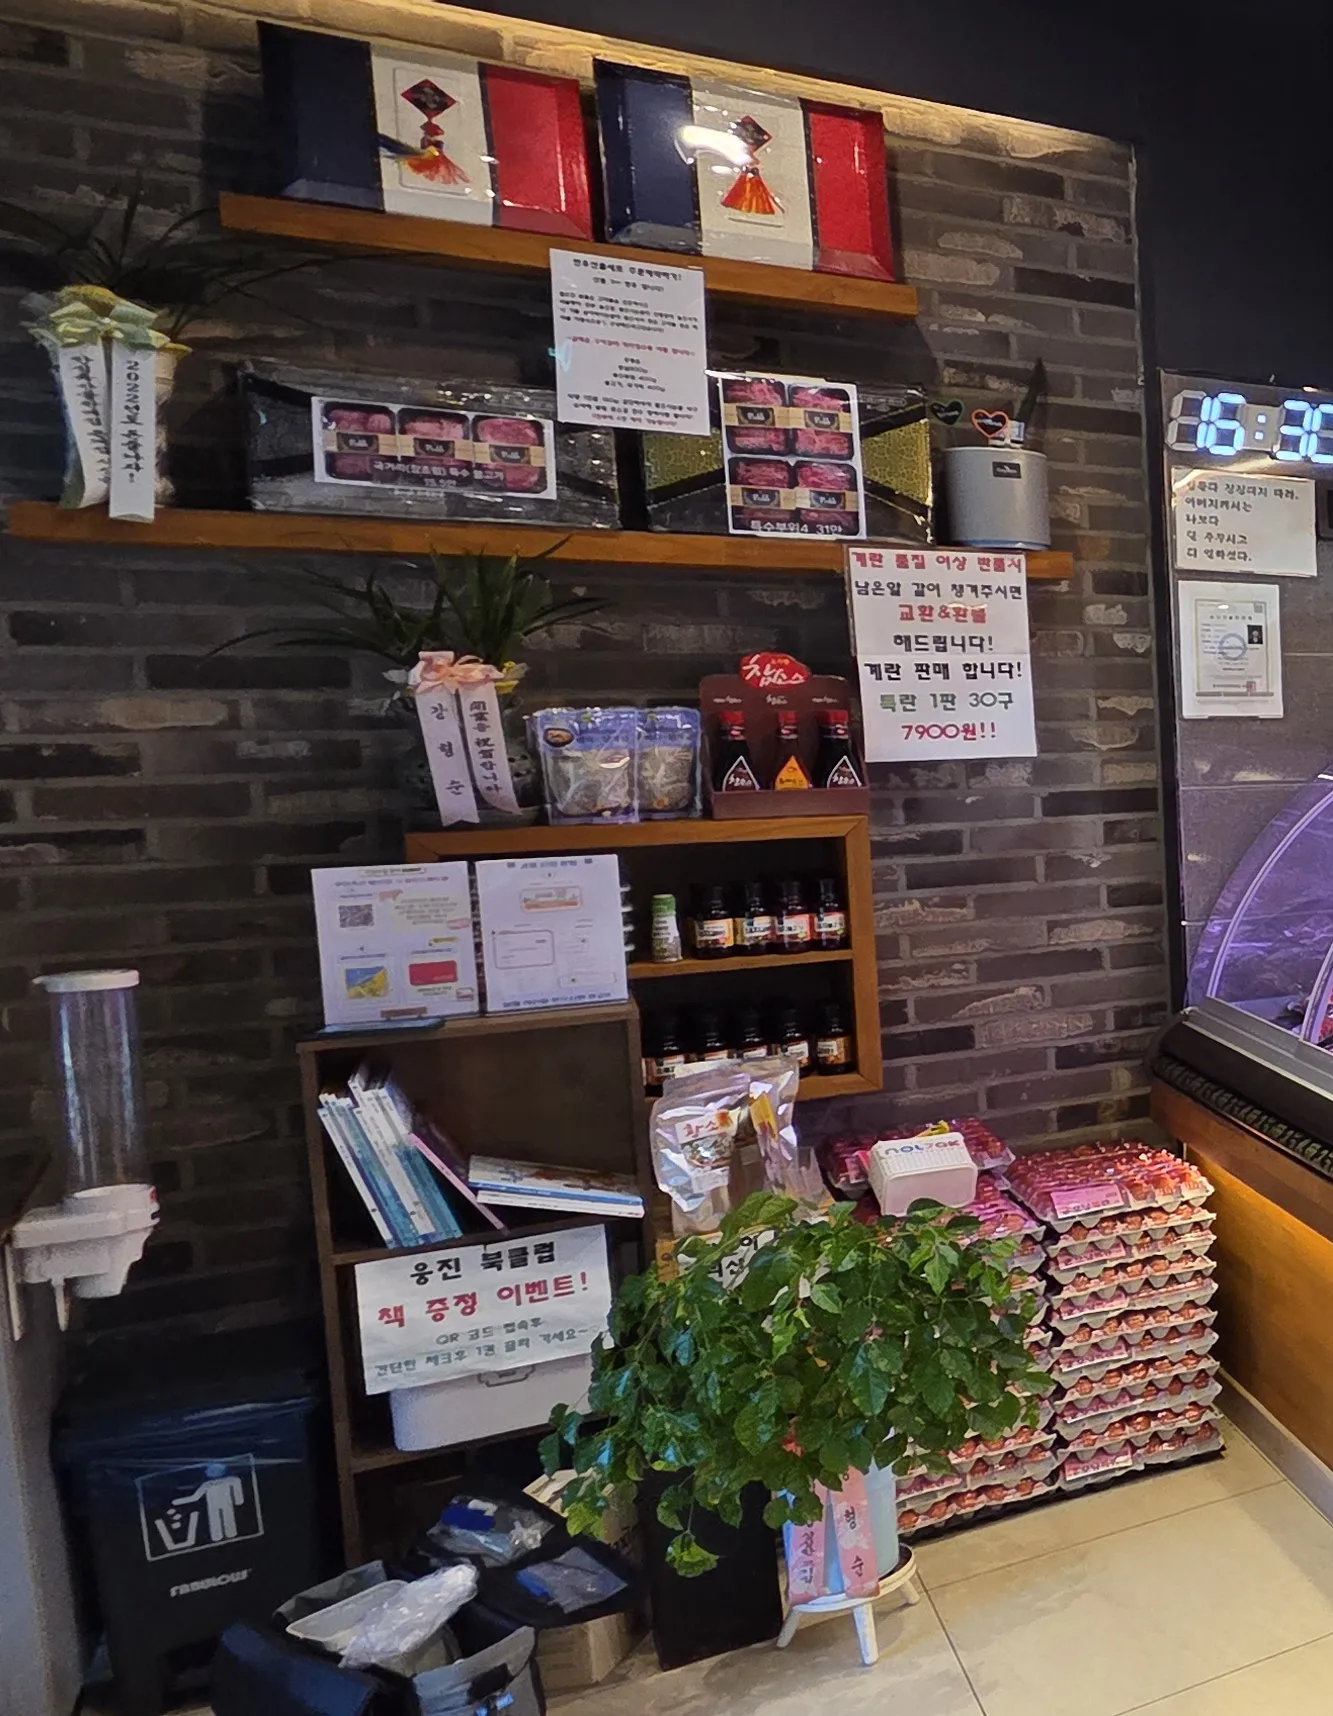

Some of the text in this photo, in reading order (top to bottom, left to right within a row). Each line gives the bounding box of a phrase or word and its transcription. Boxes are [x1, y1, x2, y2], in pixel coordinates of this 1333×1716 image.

[1185, 497, 1252, 512] 아버지께서는
[1186, 515, 1219, 526] 나보다
[852, 552, 884, 568] 계란
[896, 554, 926, 570] 품질
[935, 555, 967, 571] 이상
[855, 581, 1022, 600] 남은알 같이 챙겨주시면
[893, 634, 994, 653] 해드립니다!
[864, 661, 1023, 681] 계란 판매 합니다!
[880, 692, 1013, 712] 특란 1판 30구
[901, 722, 997, 741] 7900원!!
[410, 1241, 555, 1286] 웅진 북클럽
[377, 1271, 588, 1328] 책 증정 이벤트!
[436, 1333, 459, 1345] QR
